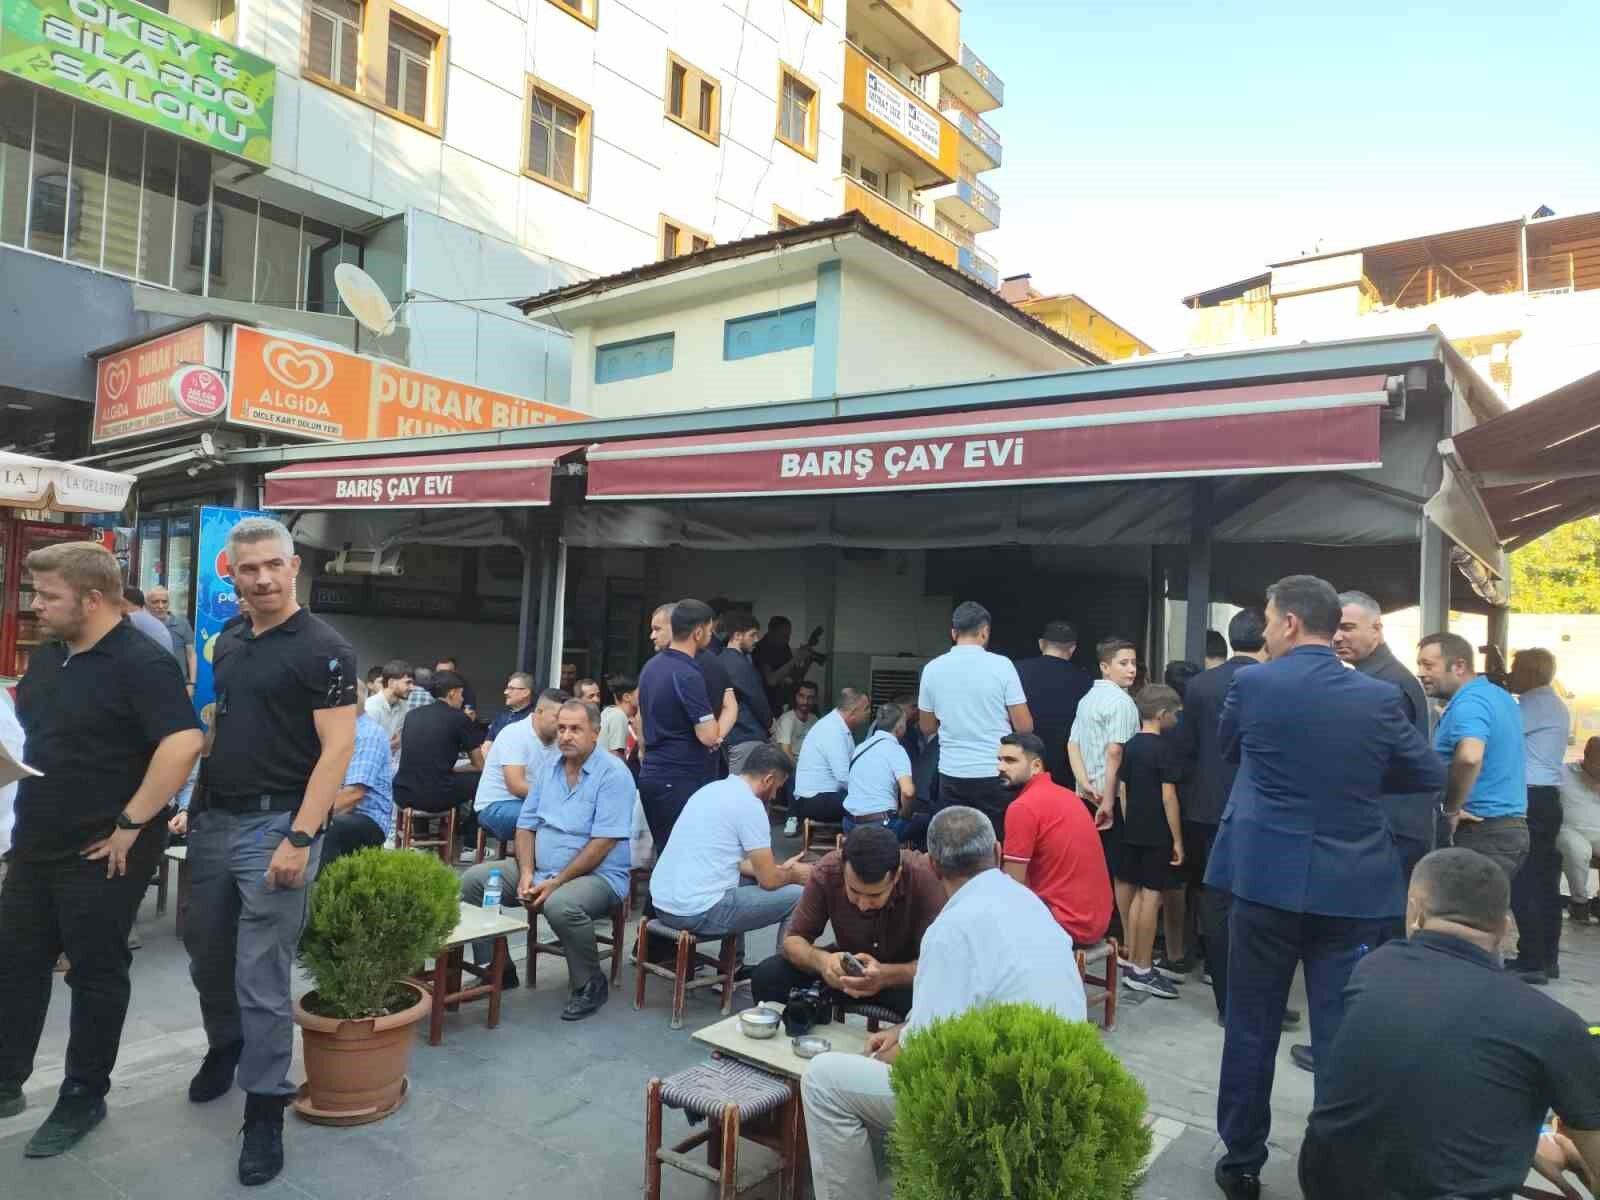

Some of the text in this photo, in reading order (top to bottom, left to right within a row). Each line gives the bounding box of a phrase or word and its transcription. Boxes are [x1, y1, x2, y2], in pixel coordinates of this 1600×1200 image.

[67, 0, 240, 82] OKEY &
[50, 50, 247, 144] SALONU
[379, 373, 483, 425] DURAK
[780, 448, 874, 481] BARIŞ
[883, 442, 953, 479] ÇAY
[335, 478, 383, 502] BARIŞ
[386, 477, 421, 502] ÇAY
